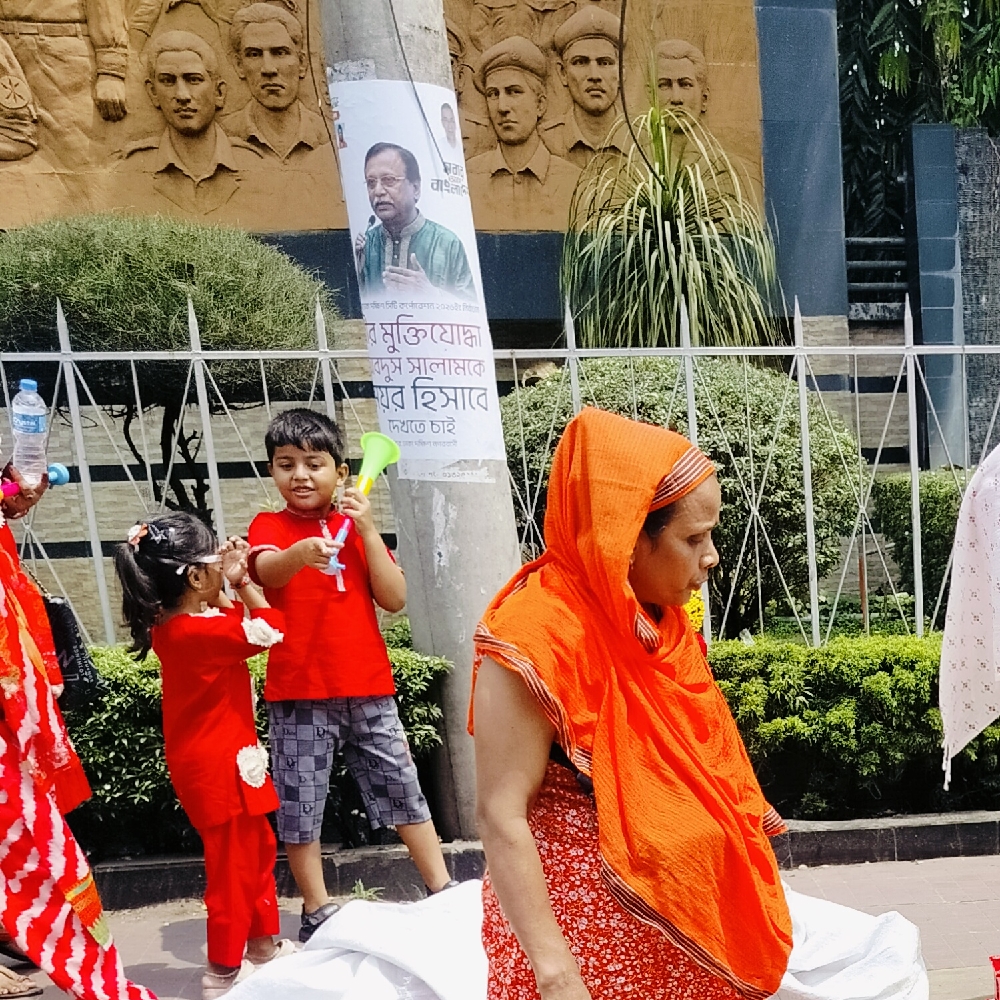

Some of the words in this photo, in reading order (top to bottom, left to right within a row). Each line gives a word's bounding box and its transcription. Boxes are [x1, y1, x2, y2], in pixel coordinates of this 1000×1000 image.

[379, 314, 481, 353] মুক্তিযোদ্ধা
[406, 357, 485, 377] সালামকে
[410, 376, 489, 411] হিসাবে
[387, 419, 426, 434] দেখতে
[429, 415, 456, 435] চাই
